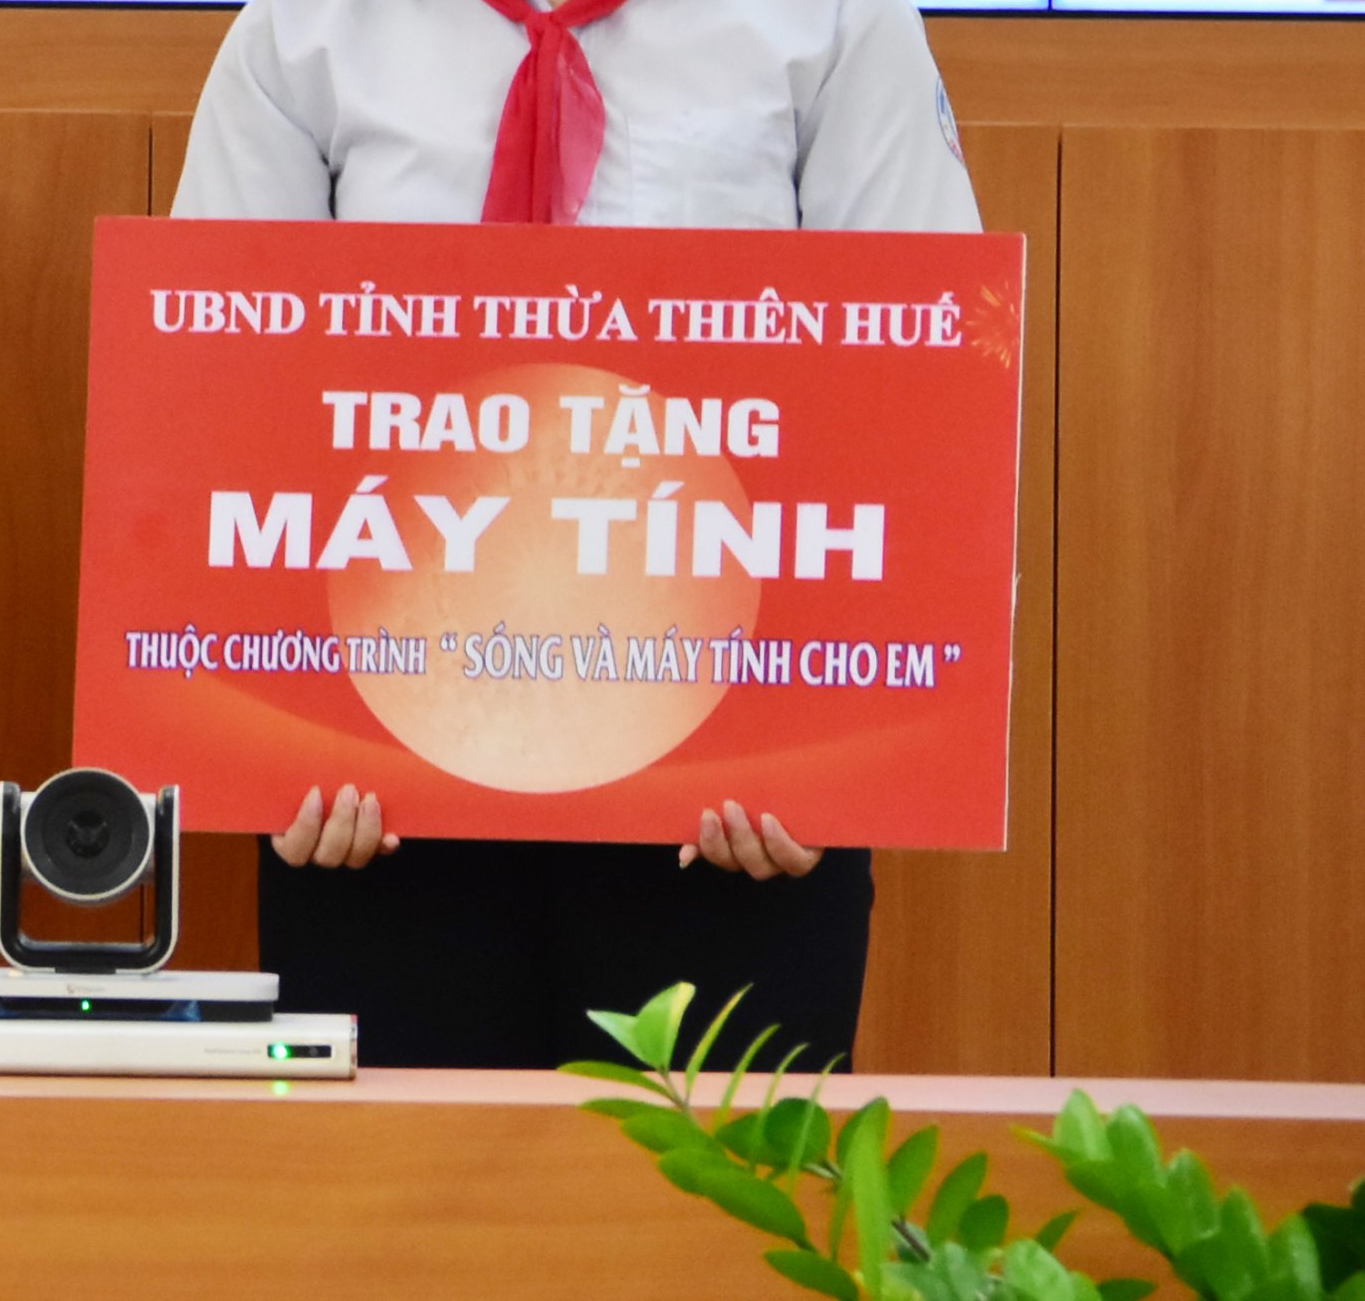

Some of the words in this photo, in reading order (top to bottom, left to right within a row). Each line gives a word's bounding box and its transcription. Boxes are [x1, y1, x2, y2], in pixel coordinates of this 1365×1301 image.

[154, 291, 306, 333] UBND
[320, 283, 458, 337] TỈNH
[475, 285, 636, 340] THỪA
[649, 288, 826, 343] THIÊN
[845, 293, 961, 346] HUẾ
[323, 392, 530, 452] TRAO
[560, 385, 779, 468] TẶNG
[209, 475, 510, 573] MÁY
[551, 481, 885, 580] TÍNH
[126, 624, 219, 679] THUỘC
[224, 630, 342, 674] CHƯƠNG
[347, 628, 428, 675] TRÌNH
[570, 624, 621, 683] VÀ
[624, 627, 704, 684] MÁY
[709, 628, 793, 685] TÍNH
[799, 641, 880, 687] CHO
